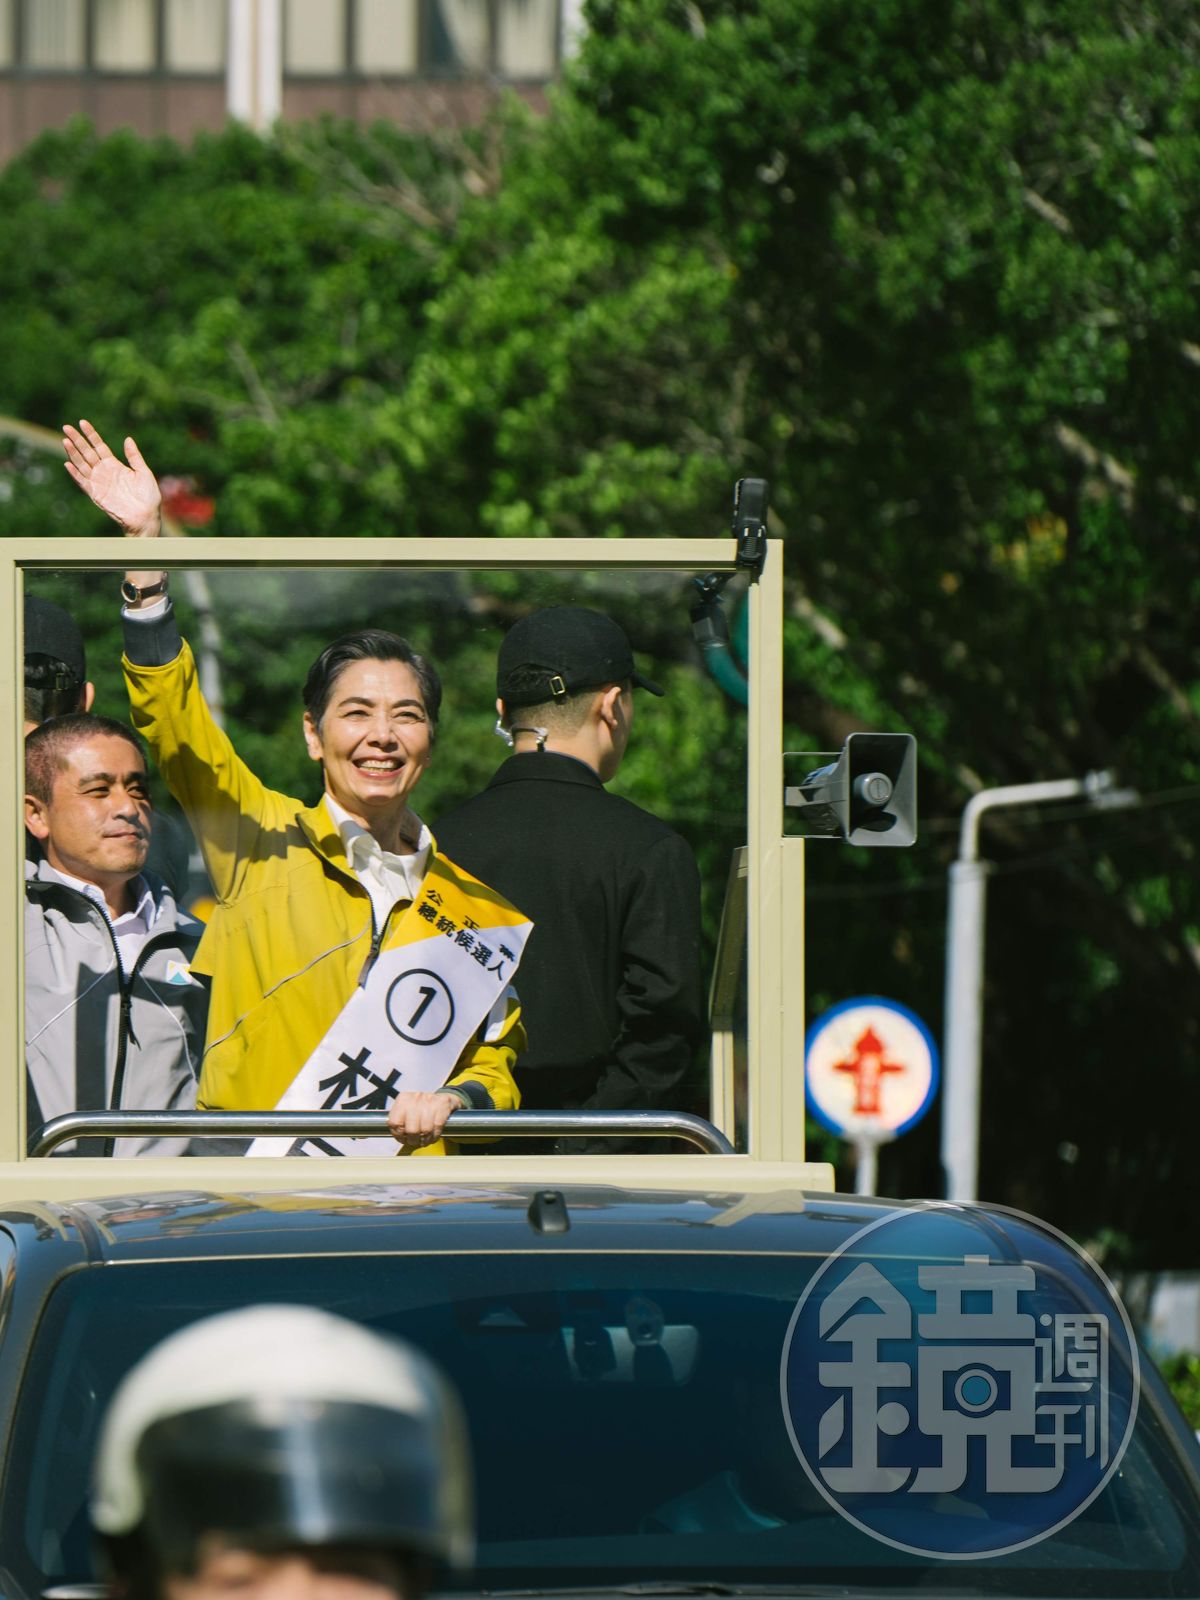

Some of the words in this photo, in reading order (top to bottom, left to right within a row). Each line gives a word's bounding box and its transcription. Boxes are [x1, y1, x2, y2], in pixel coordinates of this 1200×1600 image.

[417, 901, 504, 981] 總統候選人
